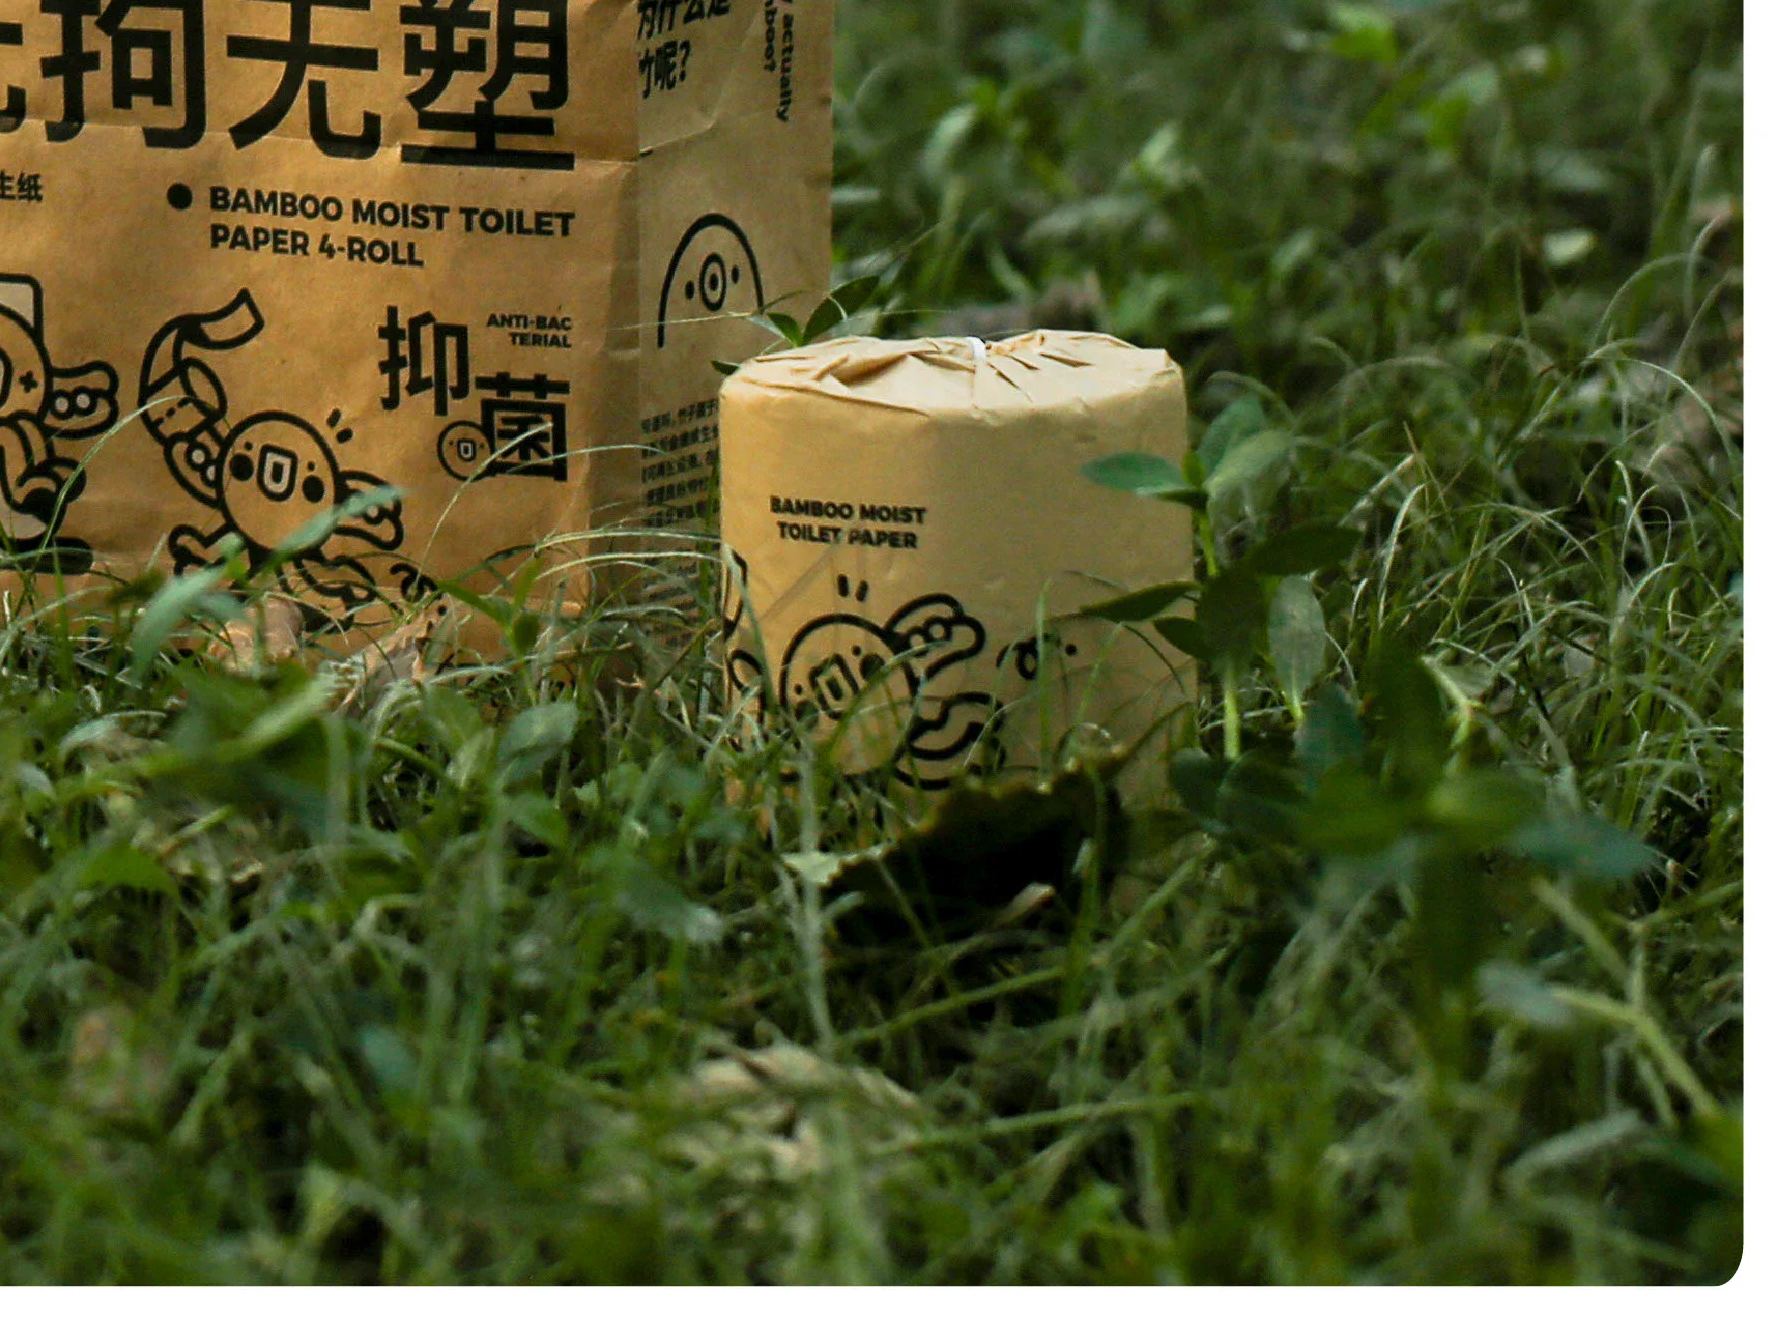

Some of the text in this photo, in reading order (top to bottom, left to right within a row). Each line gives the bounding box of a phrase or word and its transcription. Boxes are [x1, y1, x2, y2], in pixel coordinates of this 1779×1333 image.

[209, 185, 576, 238] BAMBOO MOIST TOILET
[209, 223, 426, 267] PAPER 4-ROLL
[486, 313, 572, 331] ANTI-BAC
[509, 332, 572, 349] TERIAL
[377, 304, 570, 482] 抑菌
[770, 495, 926, 525] BAMBOO MOIST
[777, 520, 918, 550] TOILET PAPER
